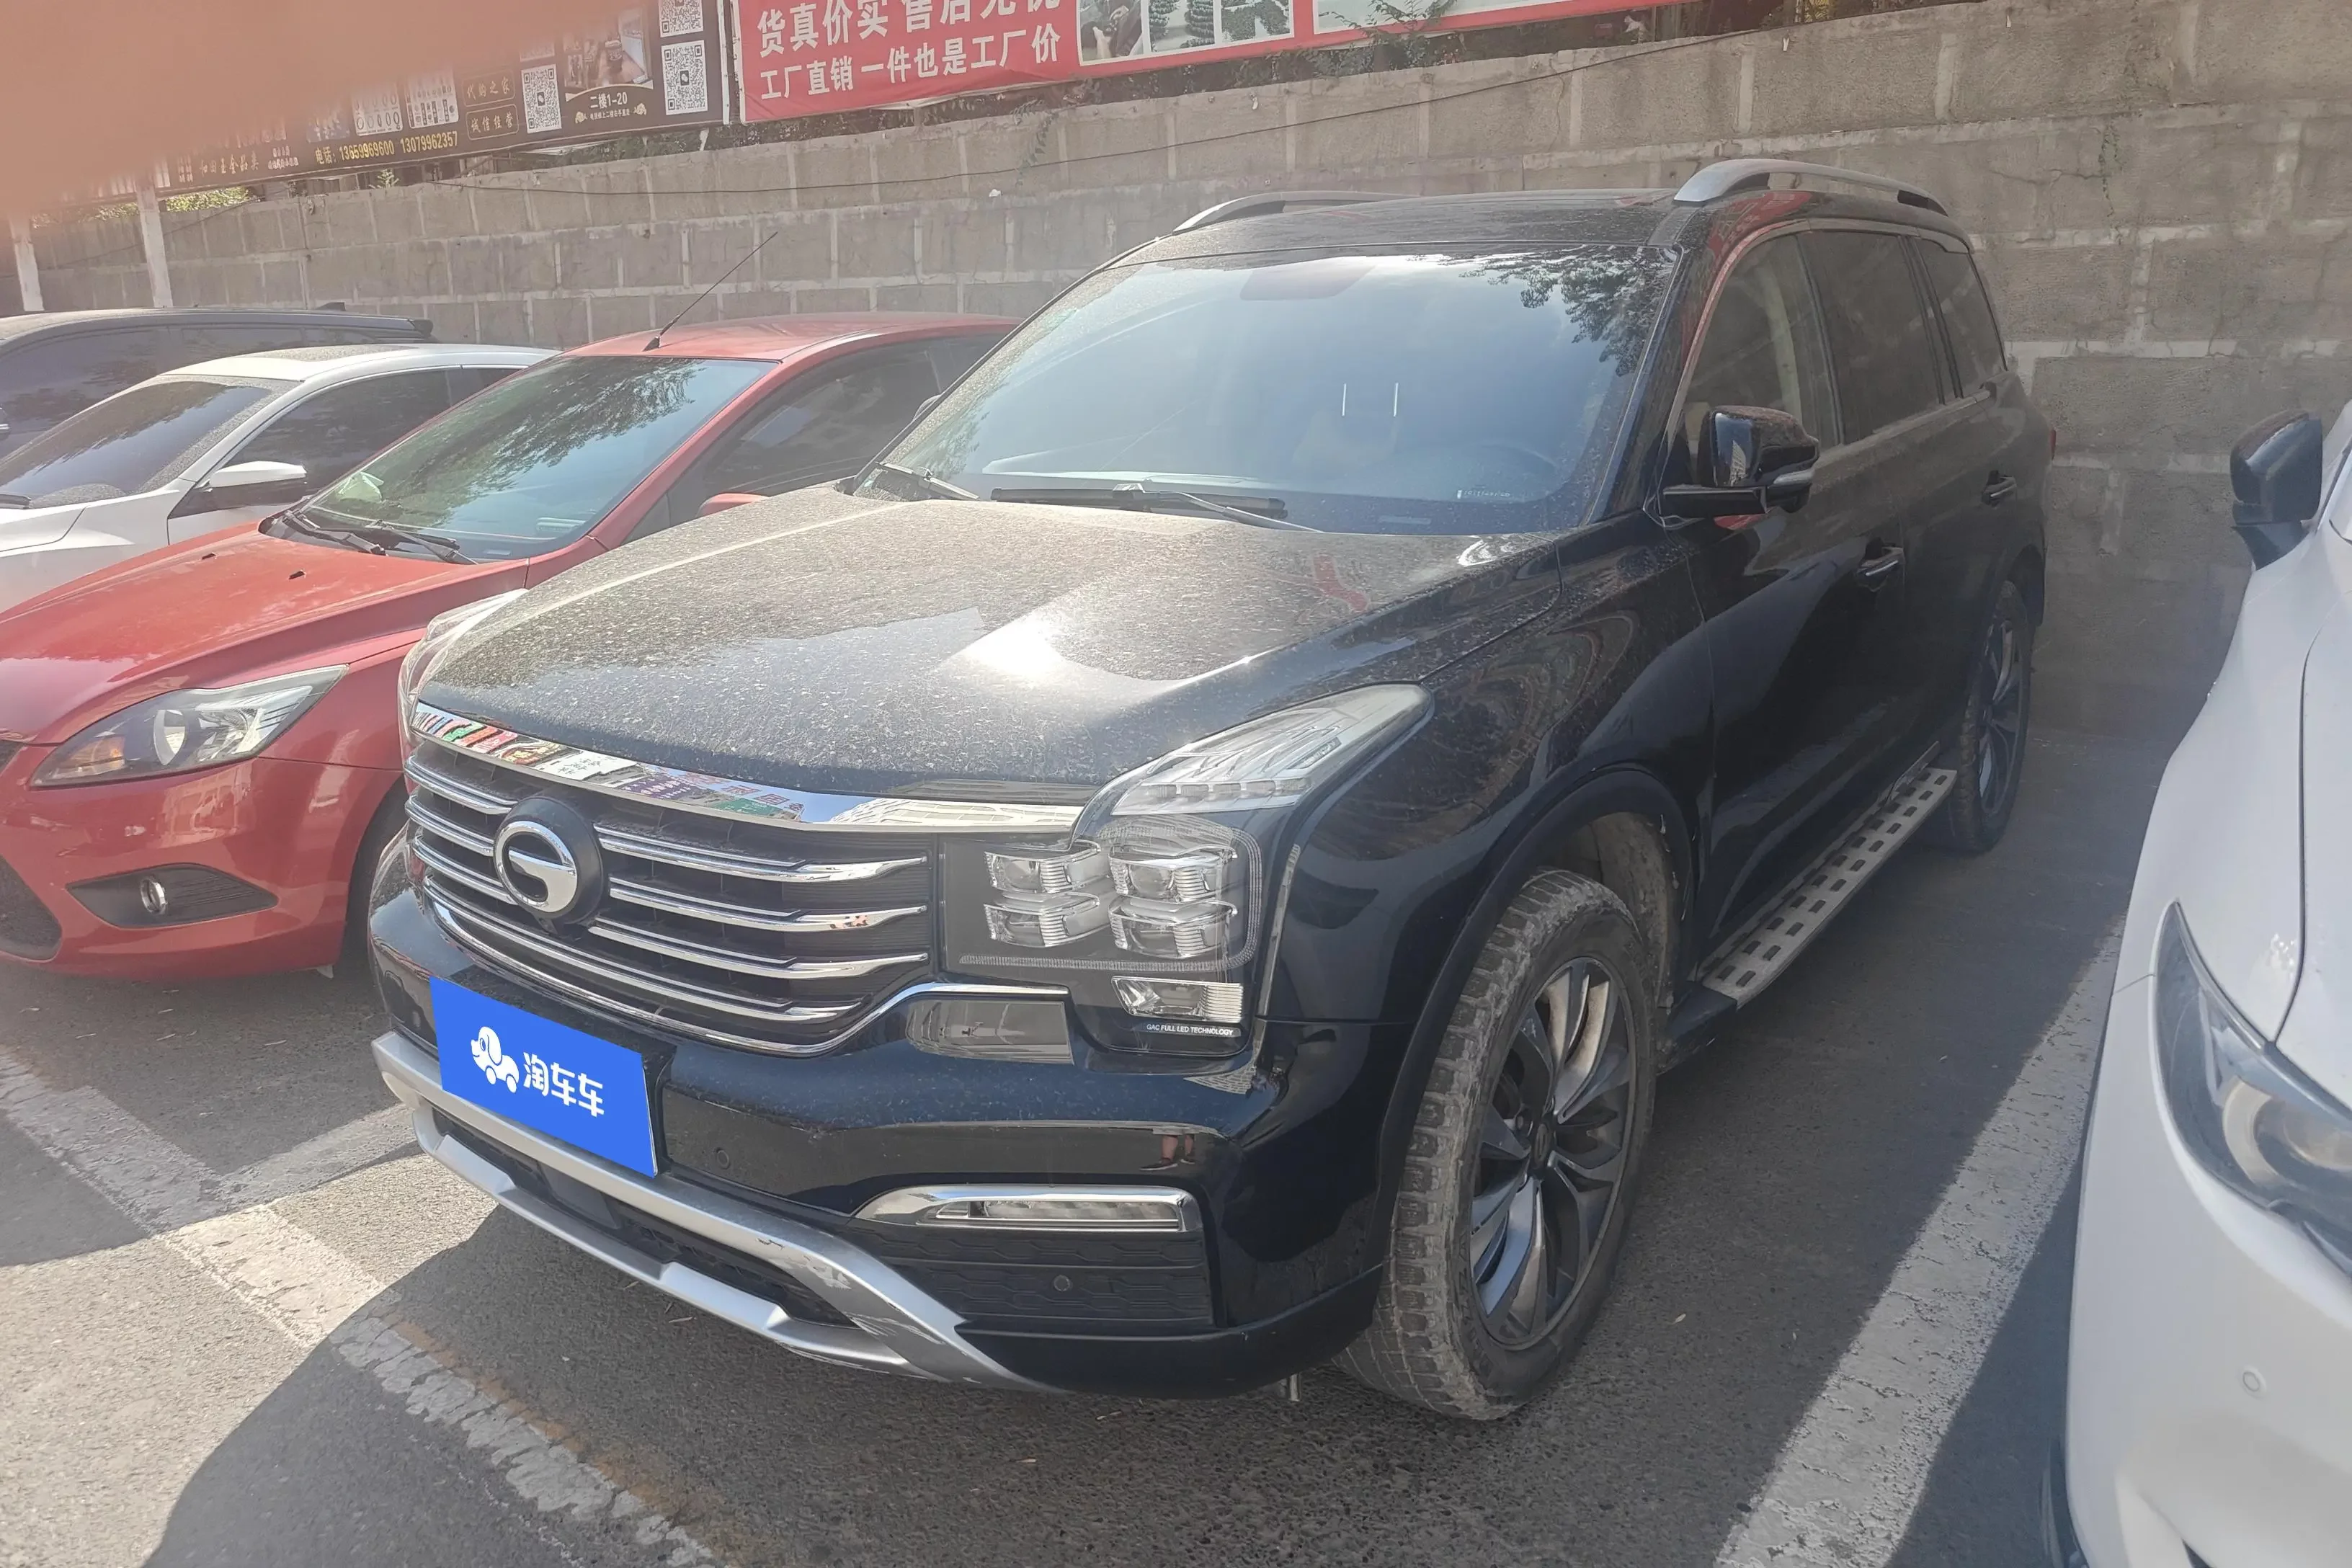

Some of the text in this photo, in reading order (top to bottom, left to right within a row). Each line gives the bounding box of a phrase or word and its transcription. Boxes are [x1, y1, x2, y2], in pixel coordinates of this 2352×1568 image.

[757, 0, 888, 58] 货真价实
[590, 92, 628, 110] 二楼1-20
[471, 110, 514, 133] 诚信经营
[339, 140, 395, 161] 13659969600
[400, 130, 458, 153] 13079962357
[1190, 1027, 1234, 1035] TECHNOLOGY
